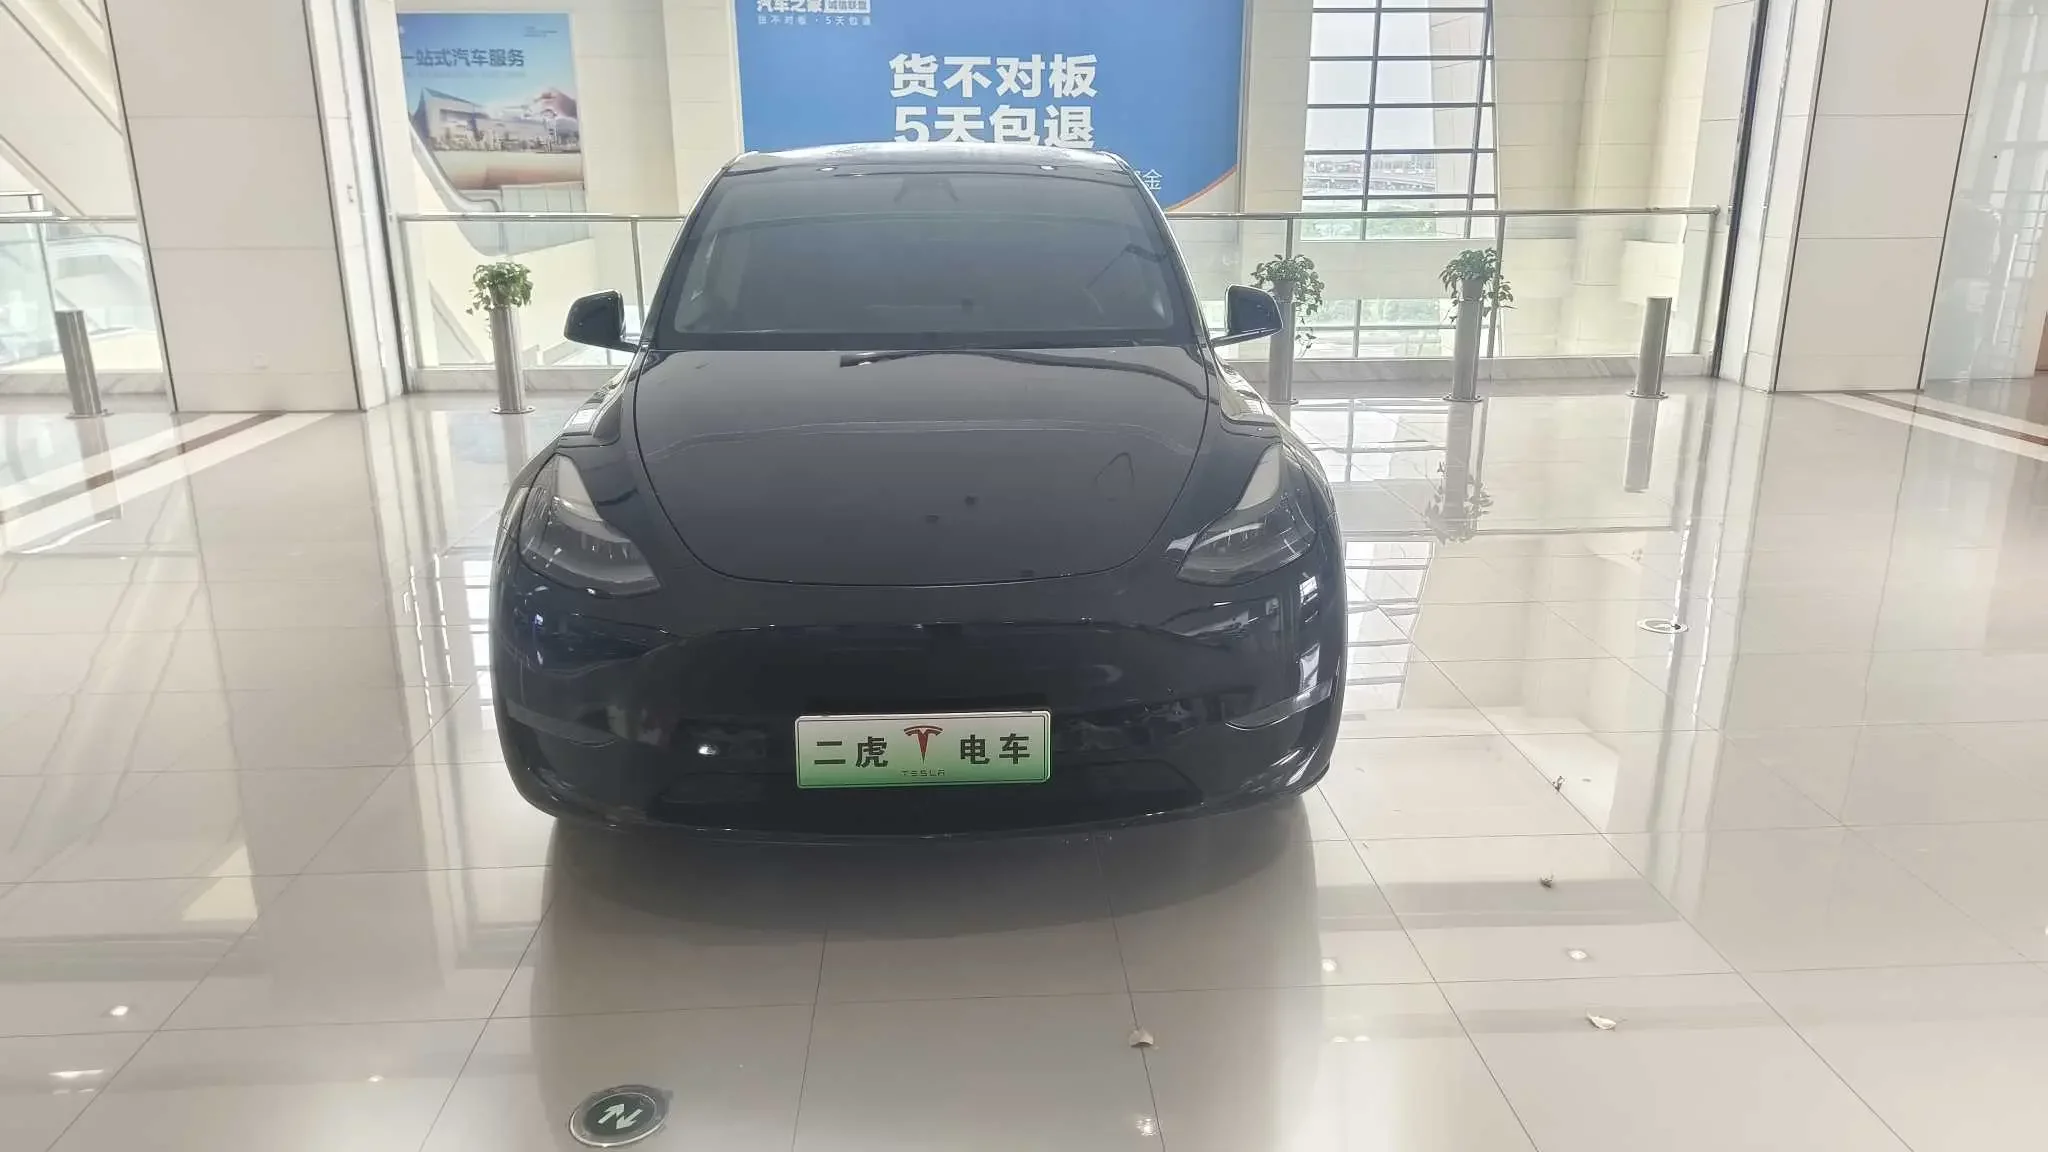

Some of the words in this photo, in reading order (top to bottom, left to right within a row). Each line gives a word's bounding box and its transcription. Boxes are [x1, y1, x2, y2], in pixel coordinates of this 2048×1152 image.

[401, 48, 525, 67] 一站式汽车服务
[889, 53, 1098, 98] 货不对板
[894, 105, 1094, 149] 5天包退
[814, 736, 888, 768] 二虎
[960, 733, 1030, 765] 电车
[901, 769, 945, 777] TESLA
